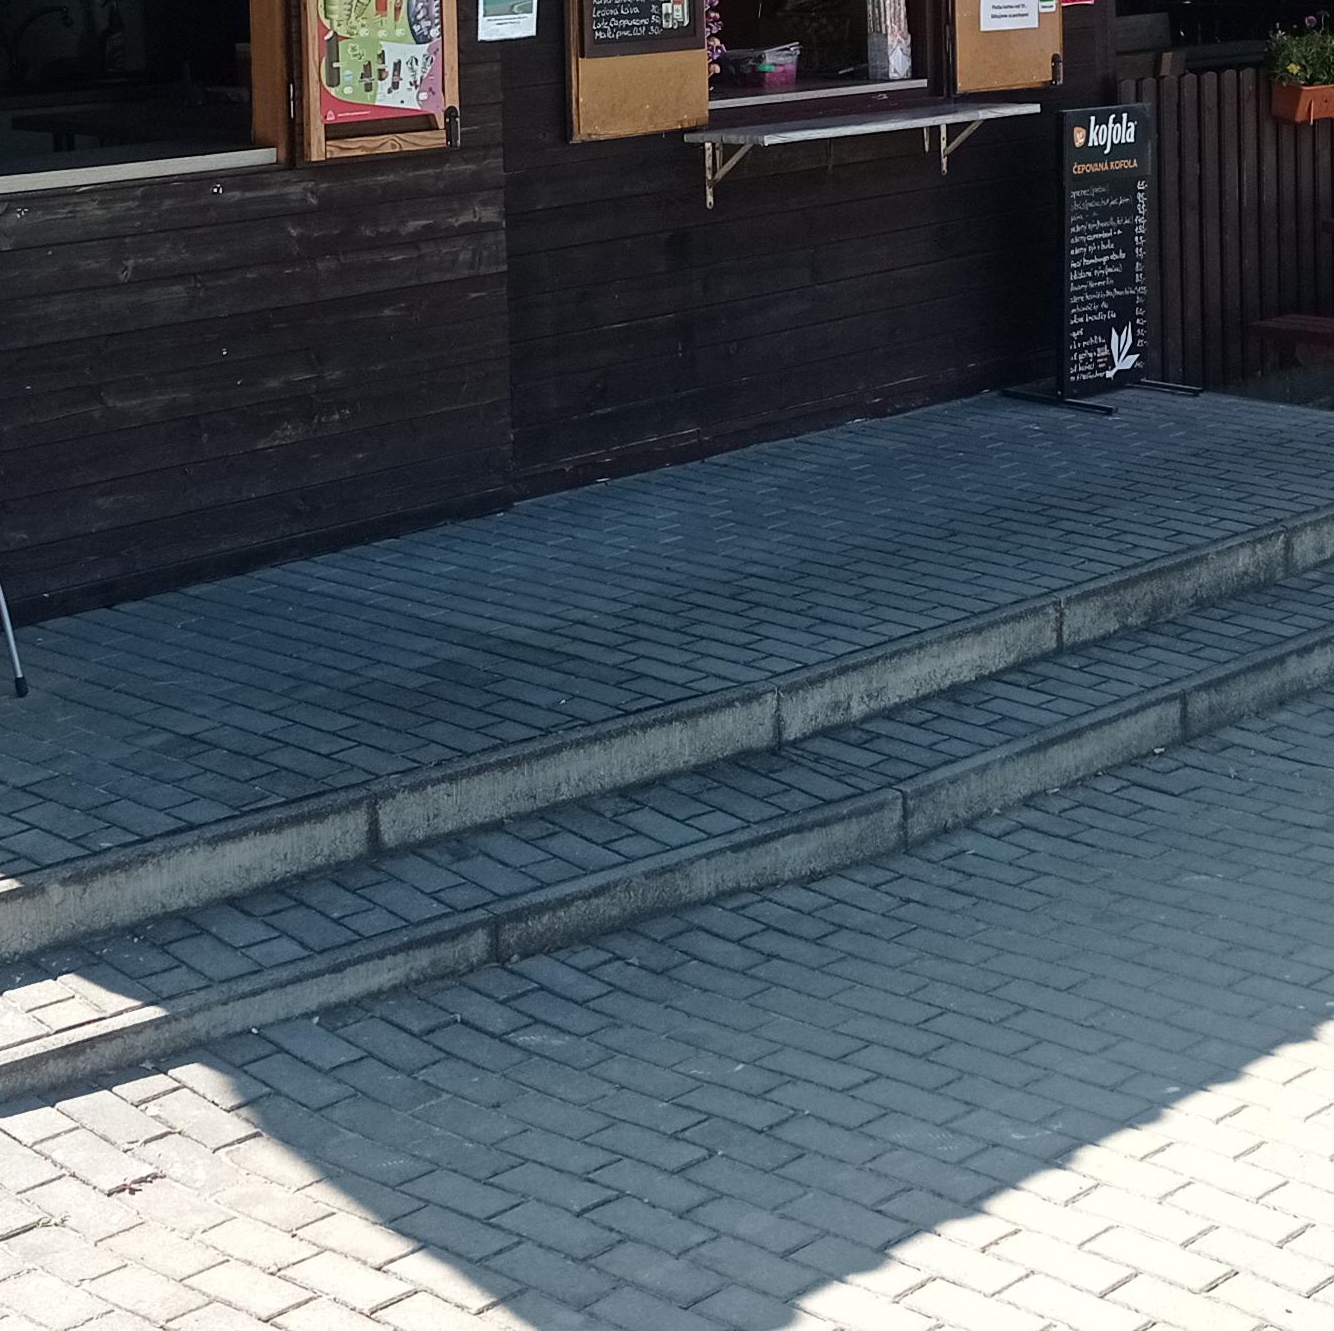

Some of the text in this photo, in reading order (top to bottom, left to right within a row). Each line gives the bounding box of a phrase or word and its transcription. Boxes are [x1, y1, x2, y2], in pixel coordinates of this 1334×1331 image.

[1087, 113, 1135, 155] kofola
[1072, 158, 1139, 175] ČEPOVANÁ KOFOLA
